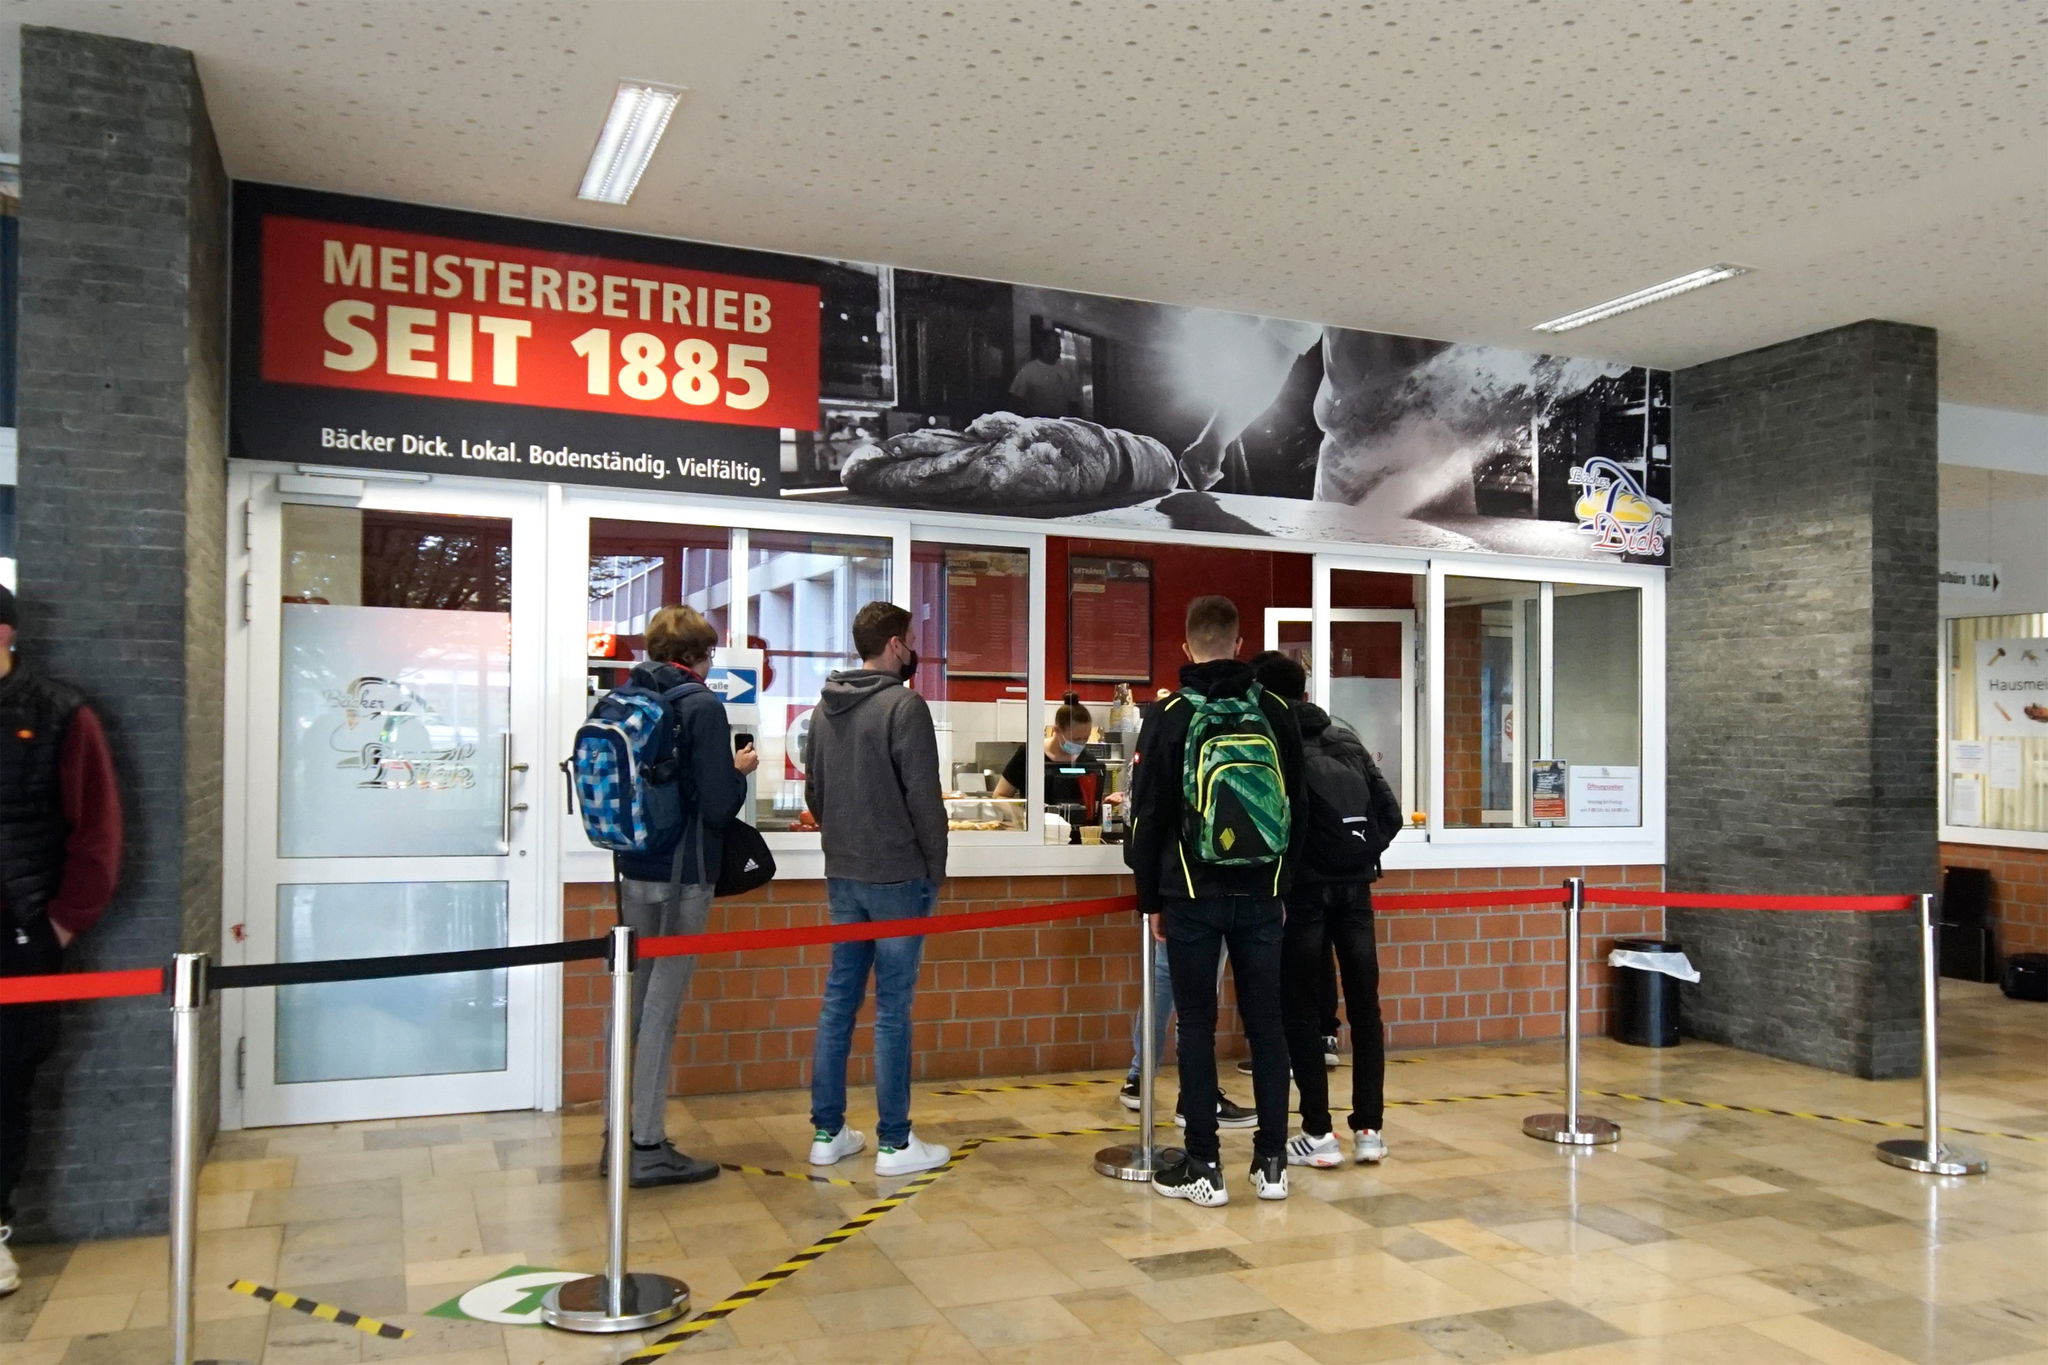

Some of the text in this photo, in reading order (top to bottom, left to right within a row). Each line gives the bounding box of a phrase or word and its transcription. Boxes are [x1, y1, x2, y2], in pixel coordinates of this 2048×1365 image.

[323, 239, 773, 334] MEISTERBETRIEB
[322, 298, 771, 411] SEIT 1885
[321, 427, 766, 487] Bäcker Dick. Lokal. Bodenständig. Vielfältig.
[1592, 513, 1664, 556] Dick
